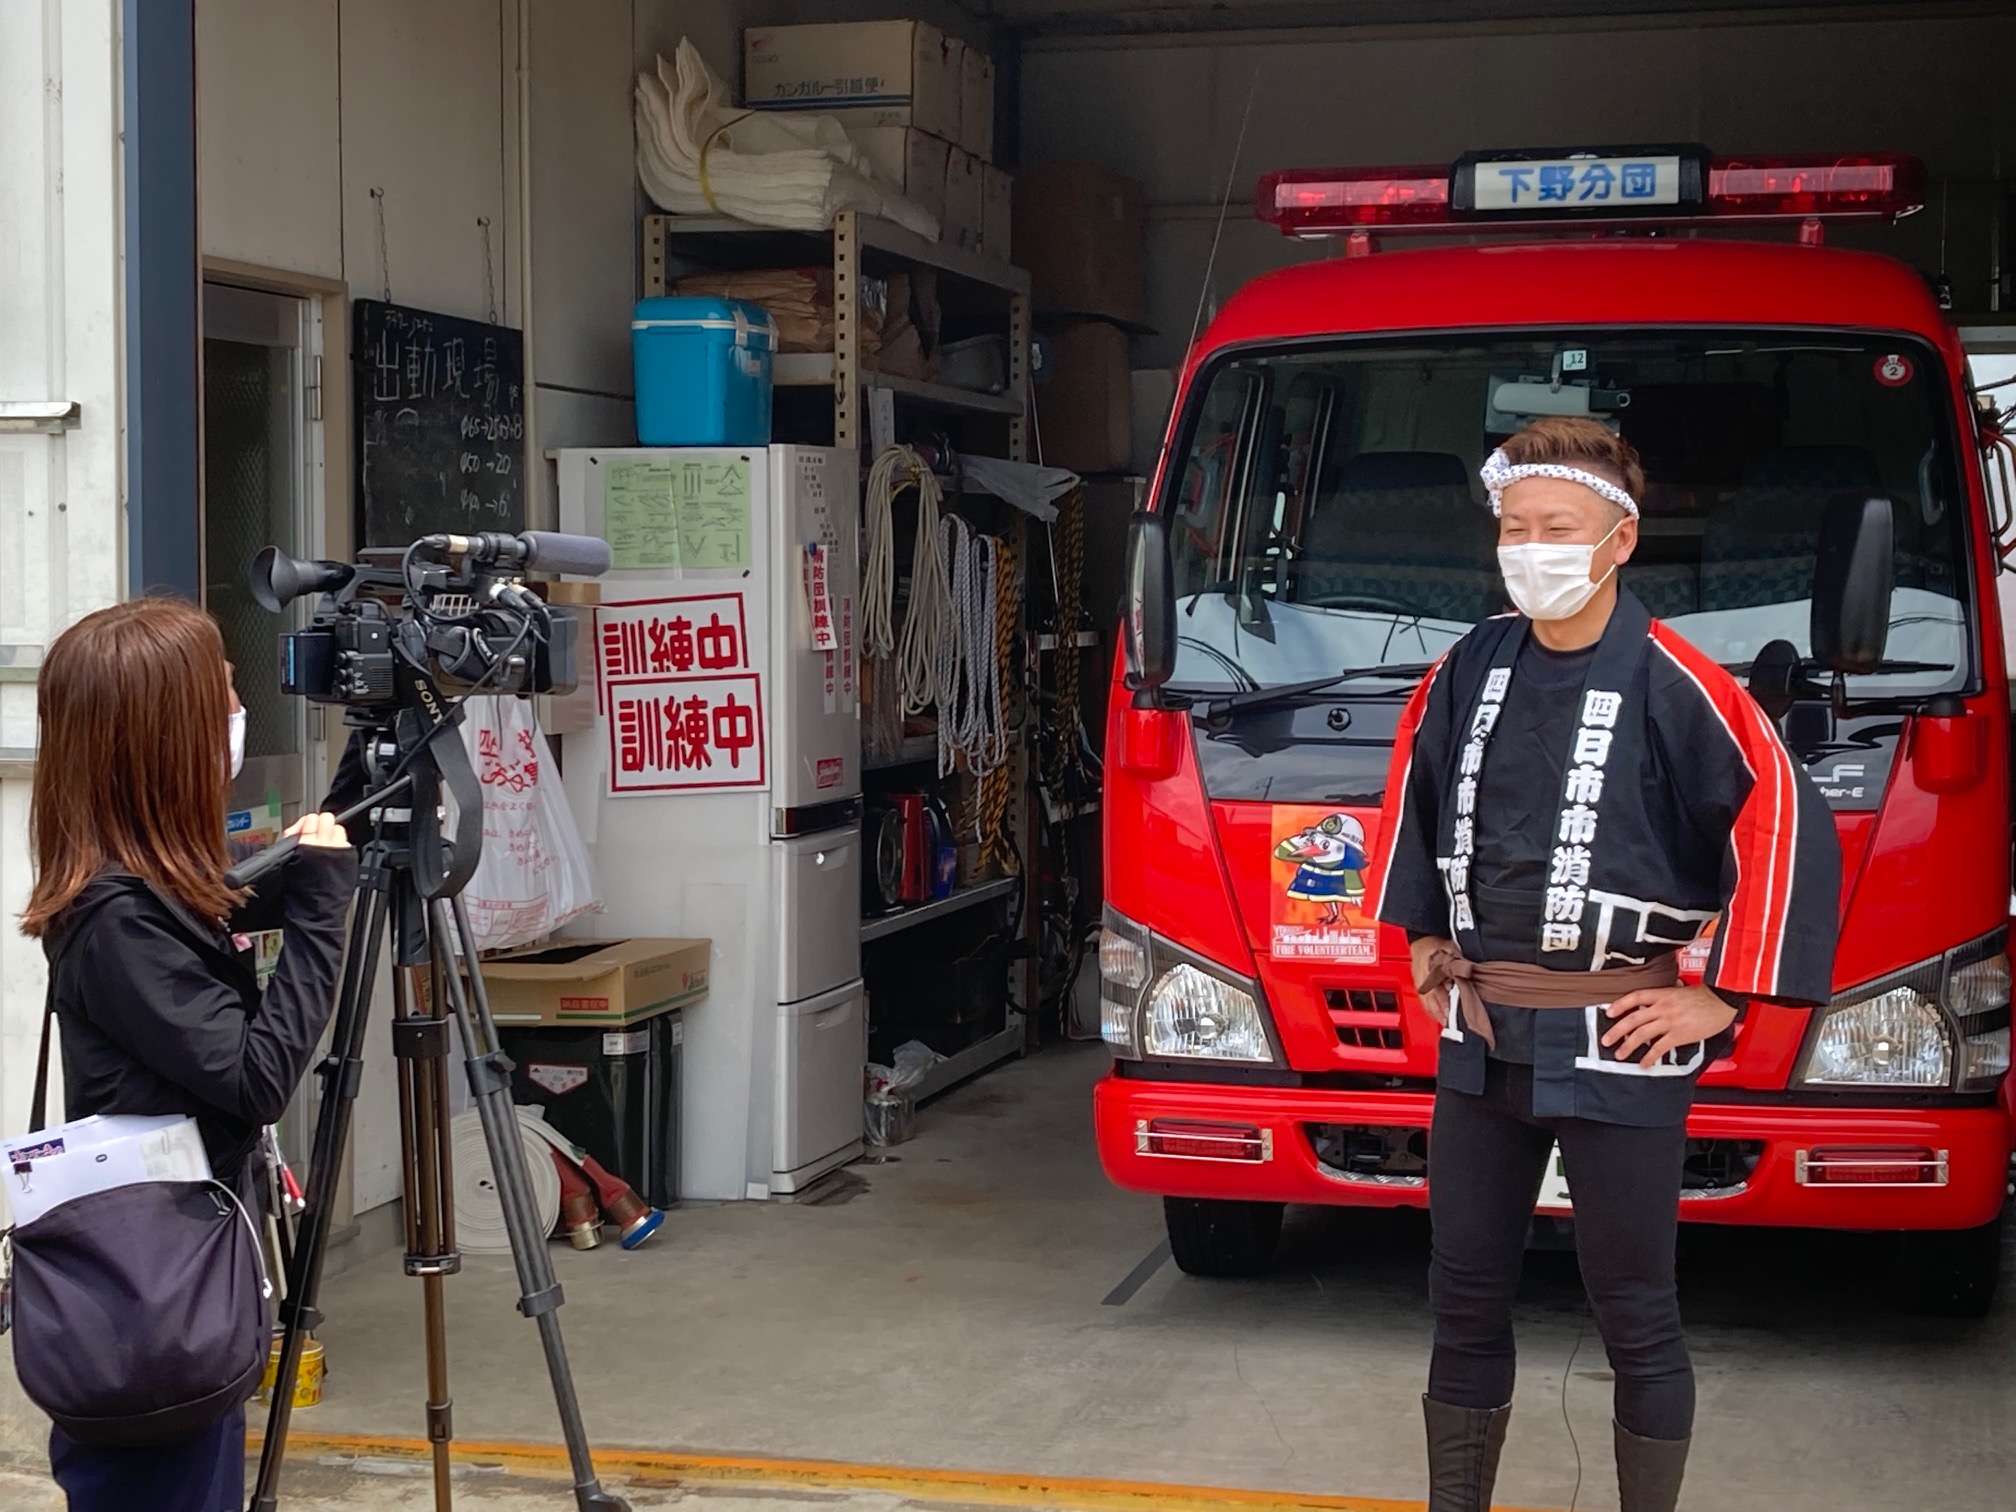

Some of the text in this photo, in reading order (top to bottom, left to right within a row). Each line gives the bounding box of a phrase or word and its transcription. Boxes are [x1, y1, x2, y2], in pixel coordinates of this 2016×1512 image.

[774, 77, 879, 97] カンガルー引越便
[1498, 163, 1657, 203] 下野分団
[374, 329, 500, 404] 出動現場
[1570, 352, 1584, 365] 12
[1889, 366, 1899, 376] 2
[602, 612, 739, 676] 訓練中
[618, 692, 755, 772] 訓練中
[1541, 688, 1623, 952] 四日市市消防団
